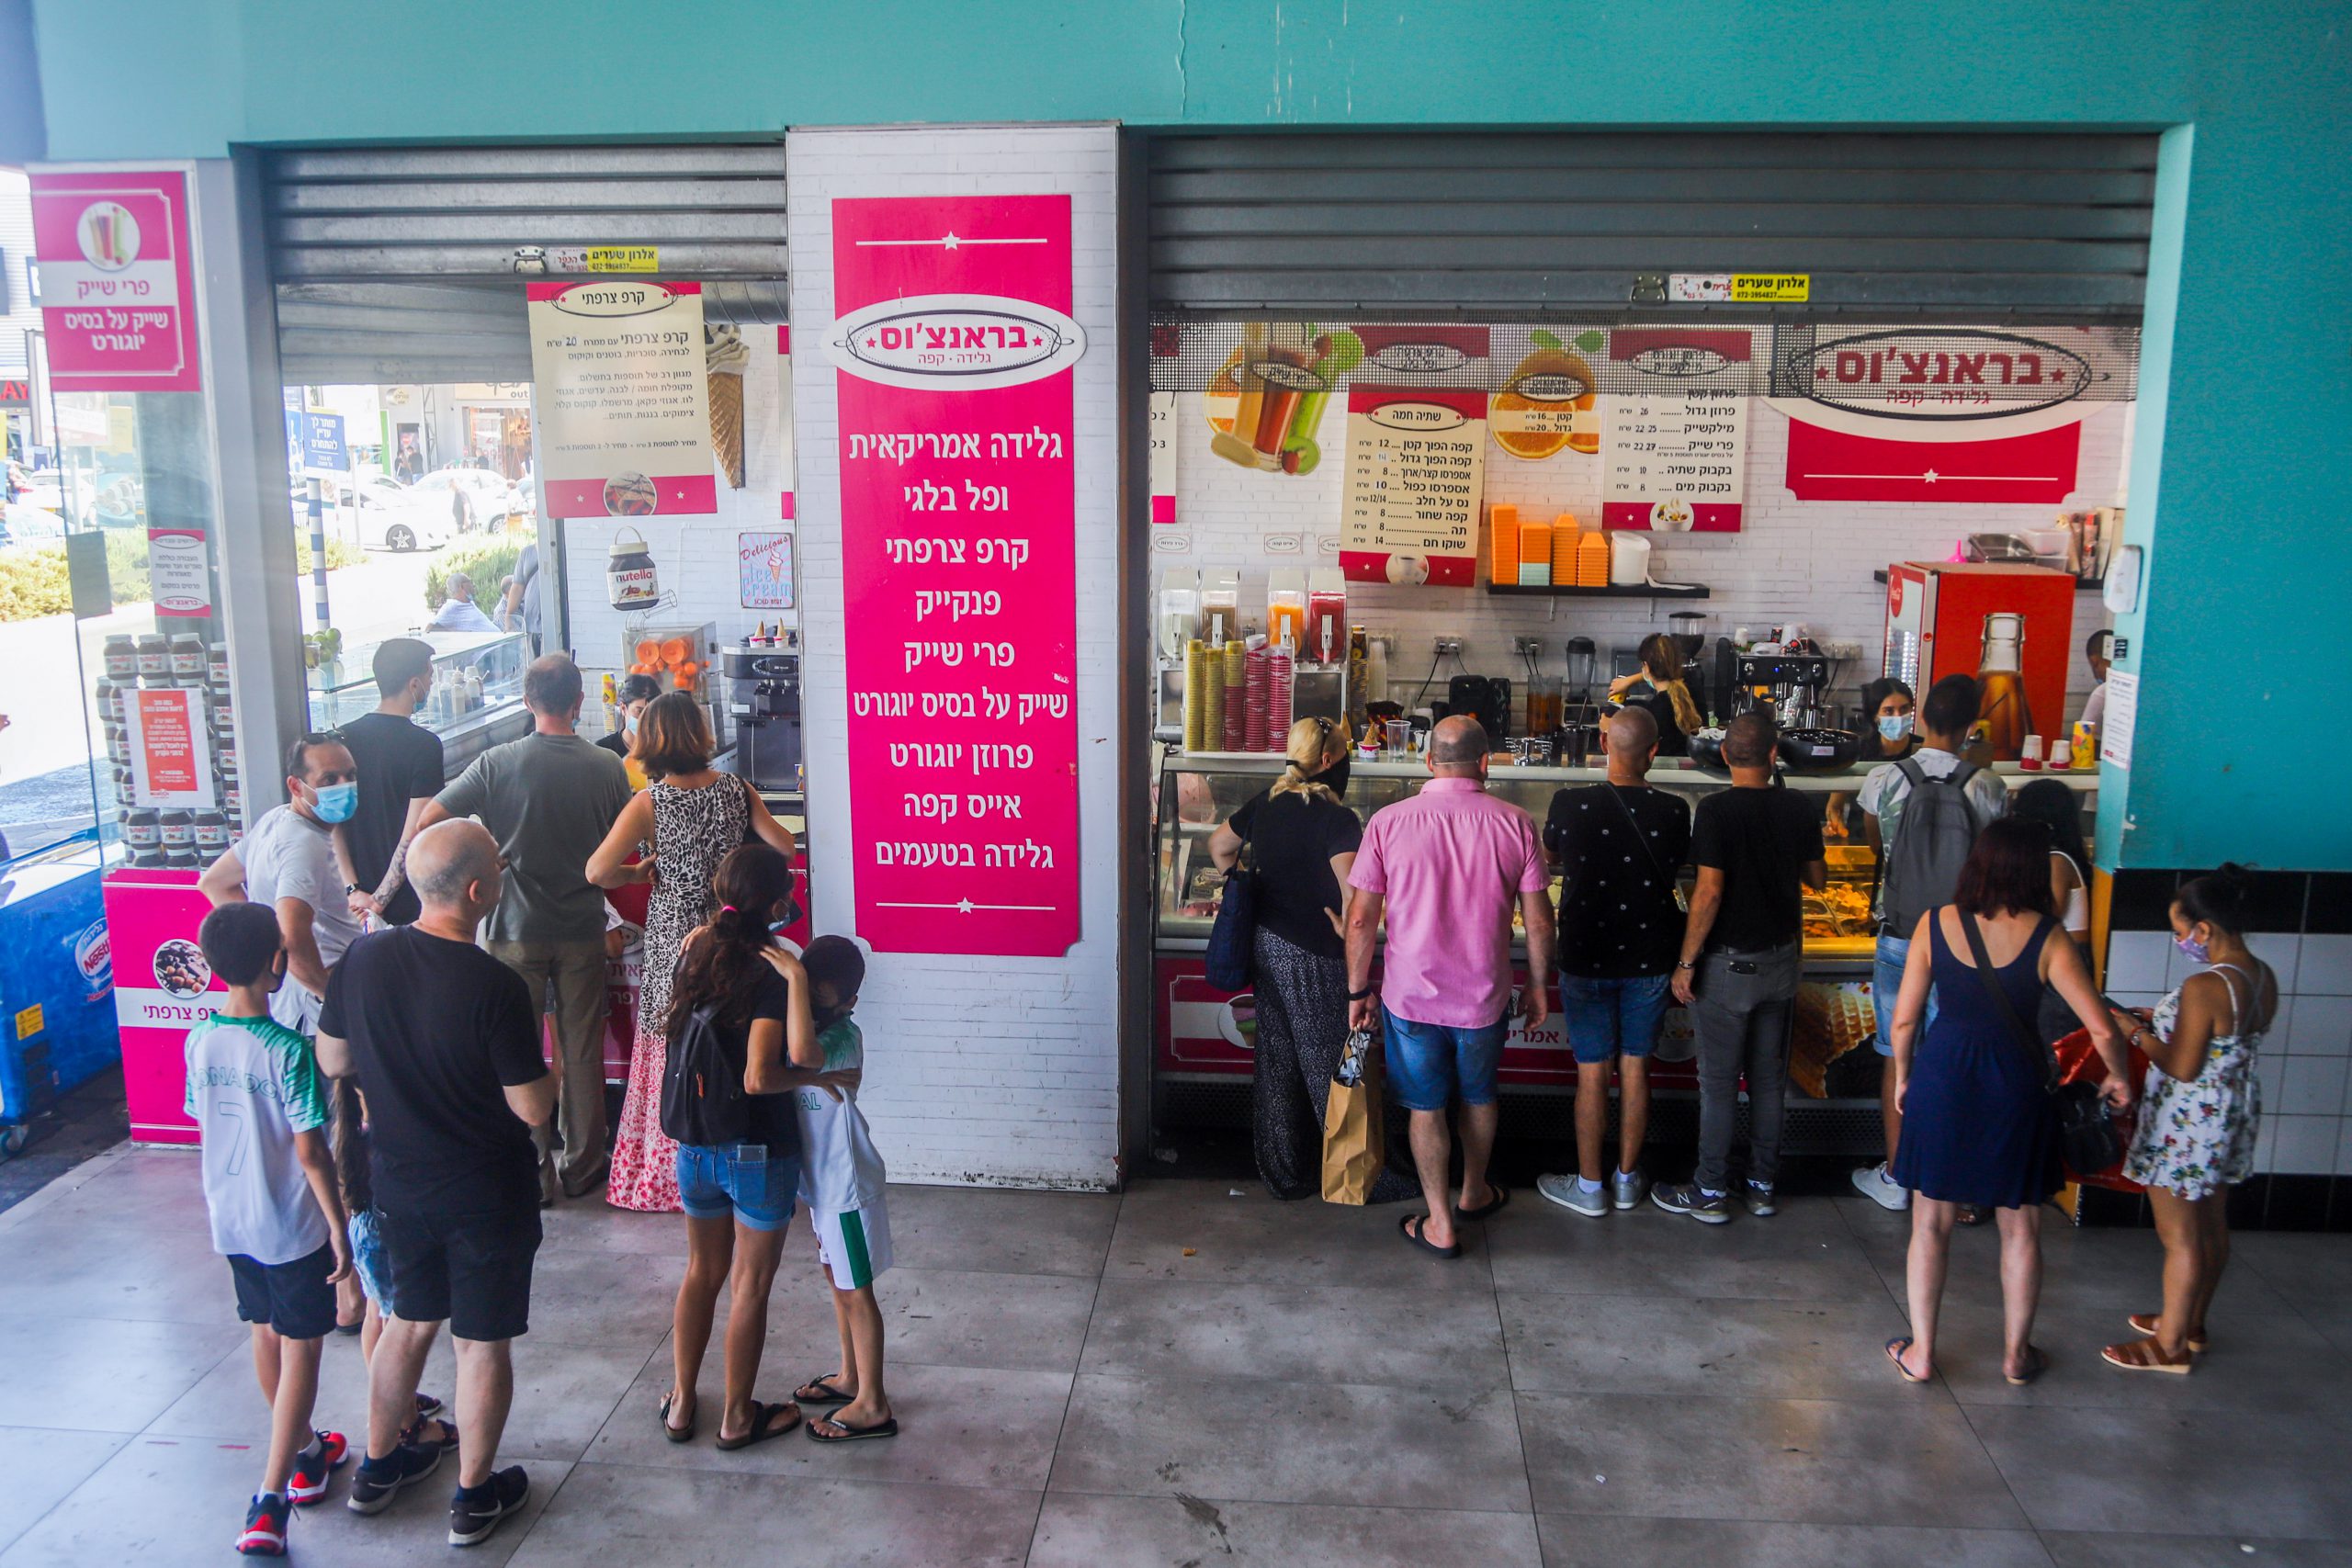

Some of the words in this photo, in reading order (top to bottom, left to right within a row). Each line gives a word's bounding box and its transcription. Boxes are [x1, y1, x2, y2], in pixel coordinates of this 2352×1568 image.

[592, 250, 625, 259] שערים
[629, 249, 654, 262] אלרון
[121, 280, 150, 296] פרי
[1738, 278, 1773, 288] שערים
[1777, 276, 1804, 290] אלרון
[77, 280, 116, 299] שייק
[582, 291, 617, 305] צרפתי
[622, 290, 645, 304] קרפ
[64, 312, 105, 329] בסיס
[107, 309, 128, 329] על
[132, 312, 169, 333] שייק
[92, 334, 145, 351] יוגורט
[566, 336, 577, 347] 20
[583, 338, 605, 347] ממרח
[621, 333, 659, 344] צרפתי
[663, 332, 689, 344] קרפ
[568, 353, 594, 361] וקוקוס
[919, 353, 944, 366] קפה
[957, 352, 990, 365] גלידה
[646, 371, 658, 379] של
[673, 371, 692, 380] מגוון
[662, 384, 693, 393] מקופלת
[511, 390, 529, 399] out
[1886, 389, 1924, 408] קפה
[1940, 388, 1991, 405] גלידה
[573, 400, 597, 409] קוקוס
[1685, 405, 1707, 415] גדול
[1393, 411, 1413, 421] חמה
[1417, 412, 1442, 421] שתיה
[1711, 407, 1736, 417] פרוזן
[1557, 413, 1573, 423] קטן
[1555, 423, 1573, 432] גדול
[1685, 423, 1735, 434] מילקשייק
[317, 428, 331, 439] עדיין
[653, 439, 679, 447] לתוספת
[990, 426, 1063, 458] גלידה
[1378, 439, 1389, 448] 12
[1404, 440, 1421, 450] קטן
[1425, 441, 1448, 452] הפוך
[1451, 443, 1473, 452] קפה
[1689, 441, 1713, 452] שייק
[1716, 442, 1734, 450] פרי
[849, 433, 981, 467] אמריקאית
[1400, 453, 1420, 463] גדול
[1424, 456, 1446, 467] הפוך
[1450, 457, 1472, 467] קפה
[1383, 468, 1388, 476] 8
[1401, 468, 1438, 479] קצר/ארוך
[1441, 470, 1471, 479] אספרסו
[1667, 465, 1696, 475] שתיה
[1700, 466, 1733, 477] בקבוק
[1404, 480, 1426, 491] כפול
[1430, 484, 1470, 494] אספרסו
[1641, 483, 1645, 491] 8
[1676, 483, 1695, 492] מים
[1698, 483, 1731, 494] בקבוק
[904, 479, 957, 512] בלגי
[965, 479, 1009, 512] ופל
[1370, 494, 1386, 503] 12/14
[1416, 496, 1436, 506] חלב
[1440, 496, 1453, 507] על
[1456, 500, 1469, 508] נס
[1416, 511, 1442, 520] שחור
[1446, 513, 1468, 523] קפה
[1379, 523, 1385, 531] 8
[1452, 526, 1466, 536] תה
[741, 536, 787, 560] Delicious
[1424, 538, 1440, 547] חם
[1442, 540, 1466, 550] שוקו
[886, 538, 966, 564] צרפתי
[976, 538, 1029, 571] קרפ
[616, 568, 652, 582] nutella
[750, 563, 772, 582] Ice
[915, 591, 1001, 623] פנקייק
[904, 642, 964, 673] שייק
[973, 642, 1016, 667] פרי
[854, 693, 913, 716] יוגורט
[922, 693, 976, 717] בסיס
[982, 686, 1011, 720] על
[1018, 694, 1069, 726] שייק
[889, 743, 963, 768] יוגורט
[972, 744, 1034, 775] פרוזן
[904, 794, 957, 825] קפה
[967, 795, 1023, 818] אייס
[876, 841, 976, 867] בטעמים
[985, 838, 1055, 869] גלידה
[143, 1005, 192, 1020] צרפתי
[219, 1101, 250, 1176] 7
